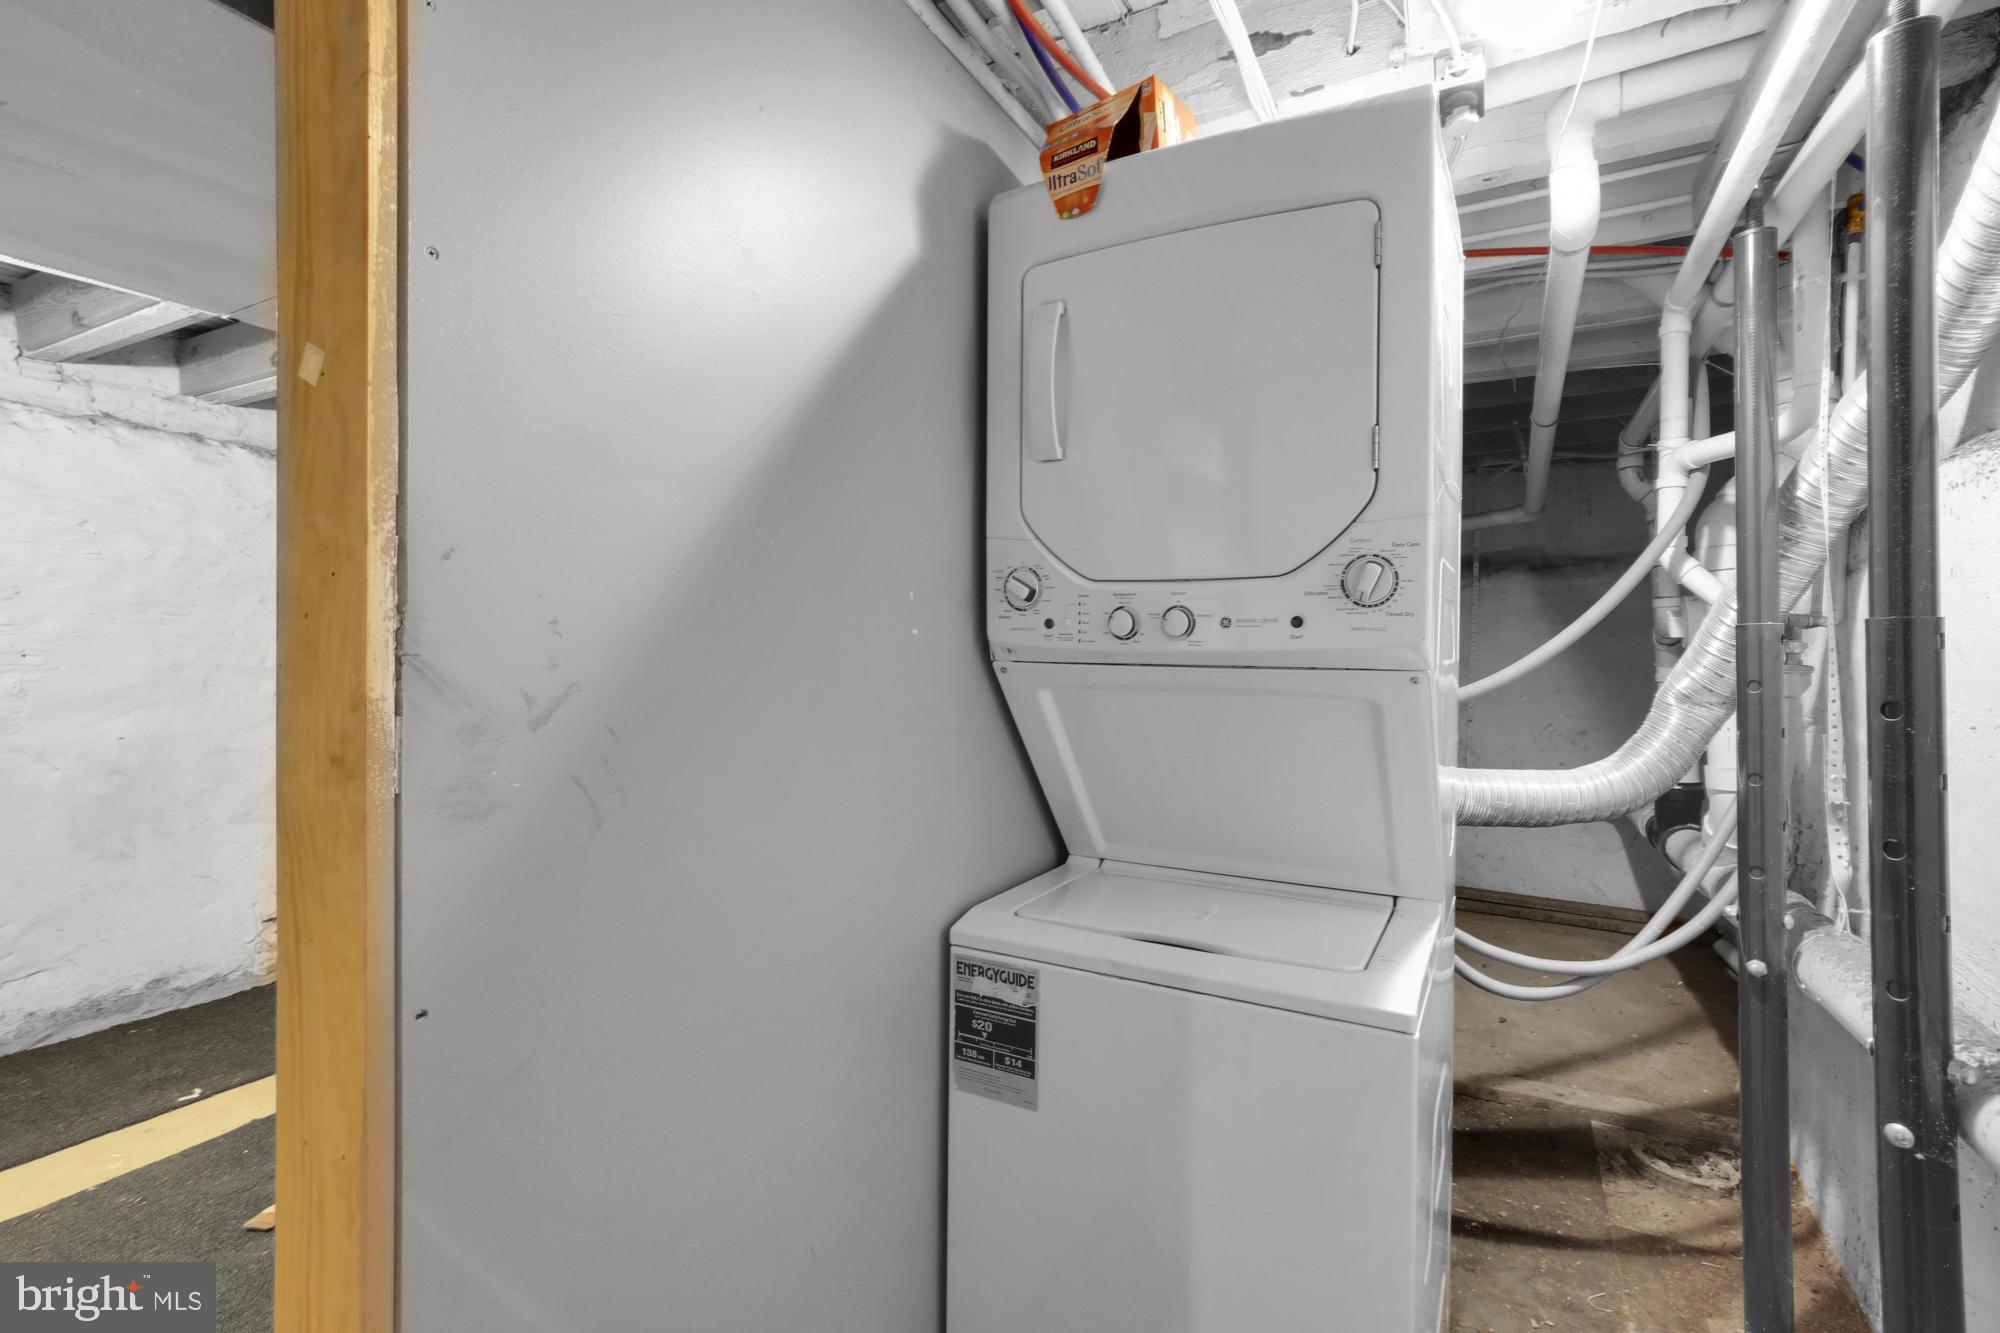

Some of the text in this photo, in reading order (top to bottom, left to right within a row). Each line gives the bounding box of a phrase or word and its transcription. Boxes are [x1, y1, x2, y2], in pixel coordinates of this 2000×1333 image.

[1052, 138, 1097, 163] KIRKLAND
[956, 960, 1035, 990] ENERGYGUIDE
[971, 1019, 993, 1032] $20
[1004, 1056, 1022, 1068] $14
